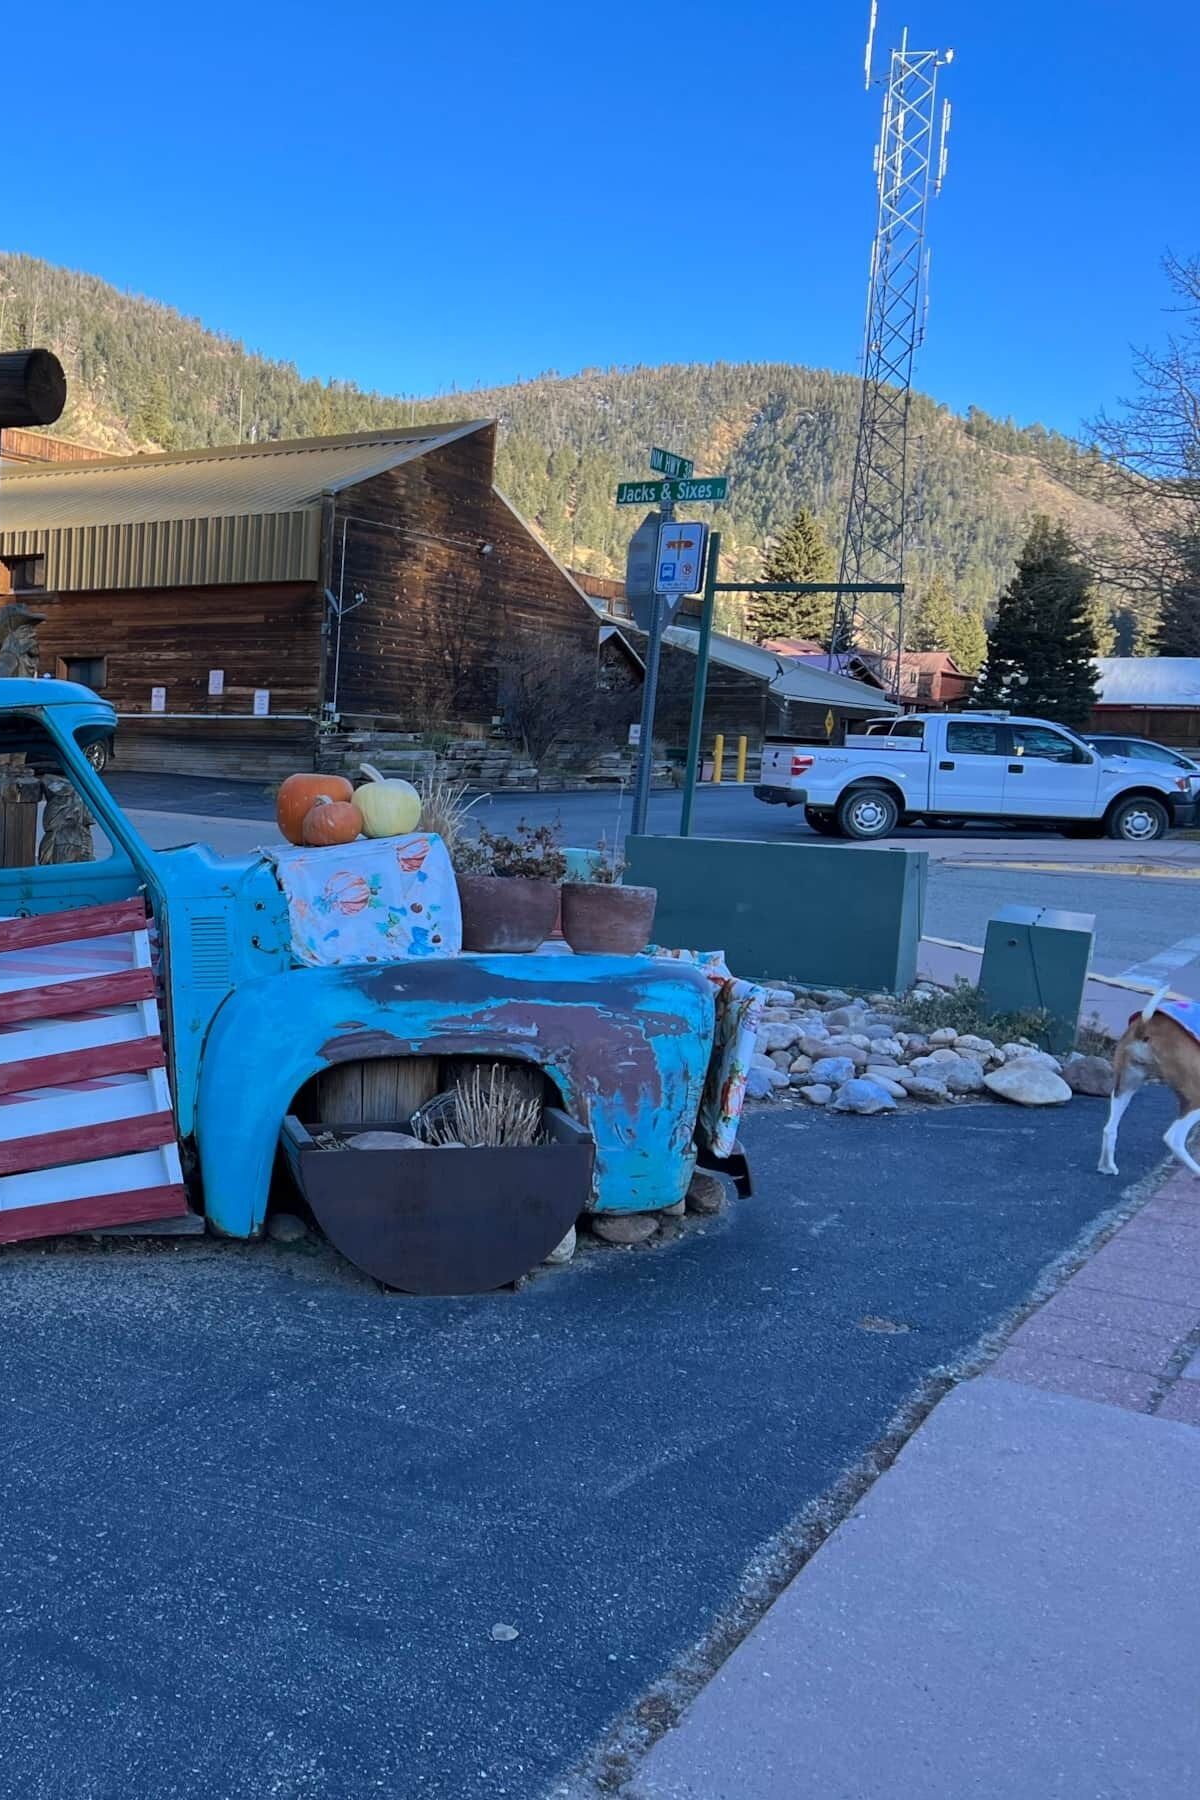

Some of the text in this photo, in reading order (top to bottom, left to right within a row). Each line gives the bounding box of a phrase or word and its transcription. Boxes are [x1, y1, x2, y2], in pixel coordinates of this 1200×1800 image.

[665, 454, 680, 478] HWY
[619, 485, 656, 503] Jacks
[661, 483, 672, 500] &
[677, 481, 712, 500] Sixes
